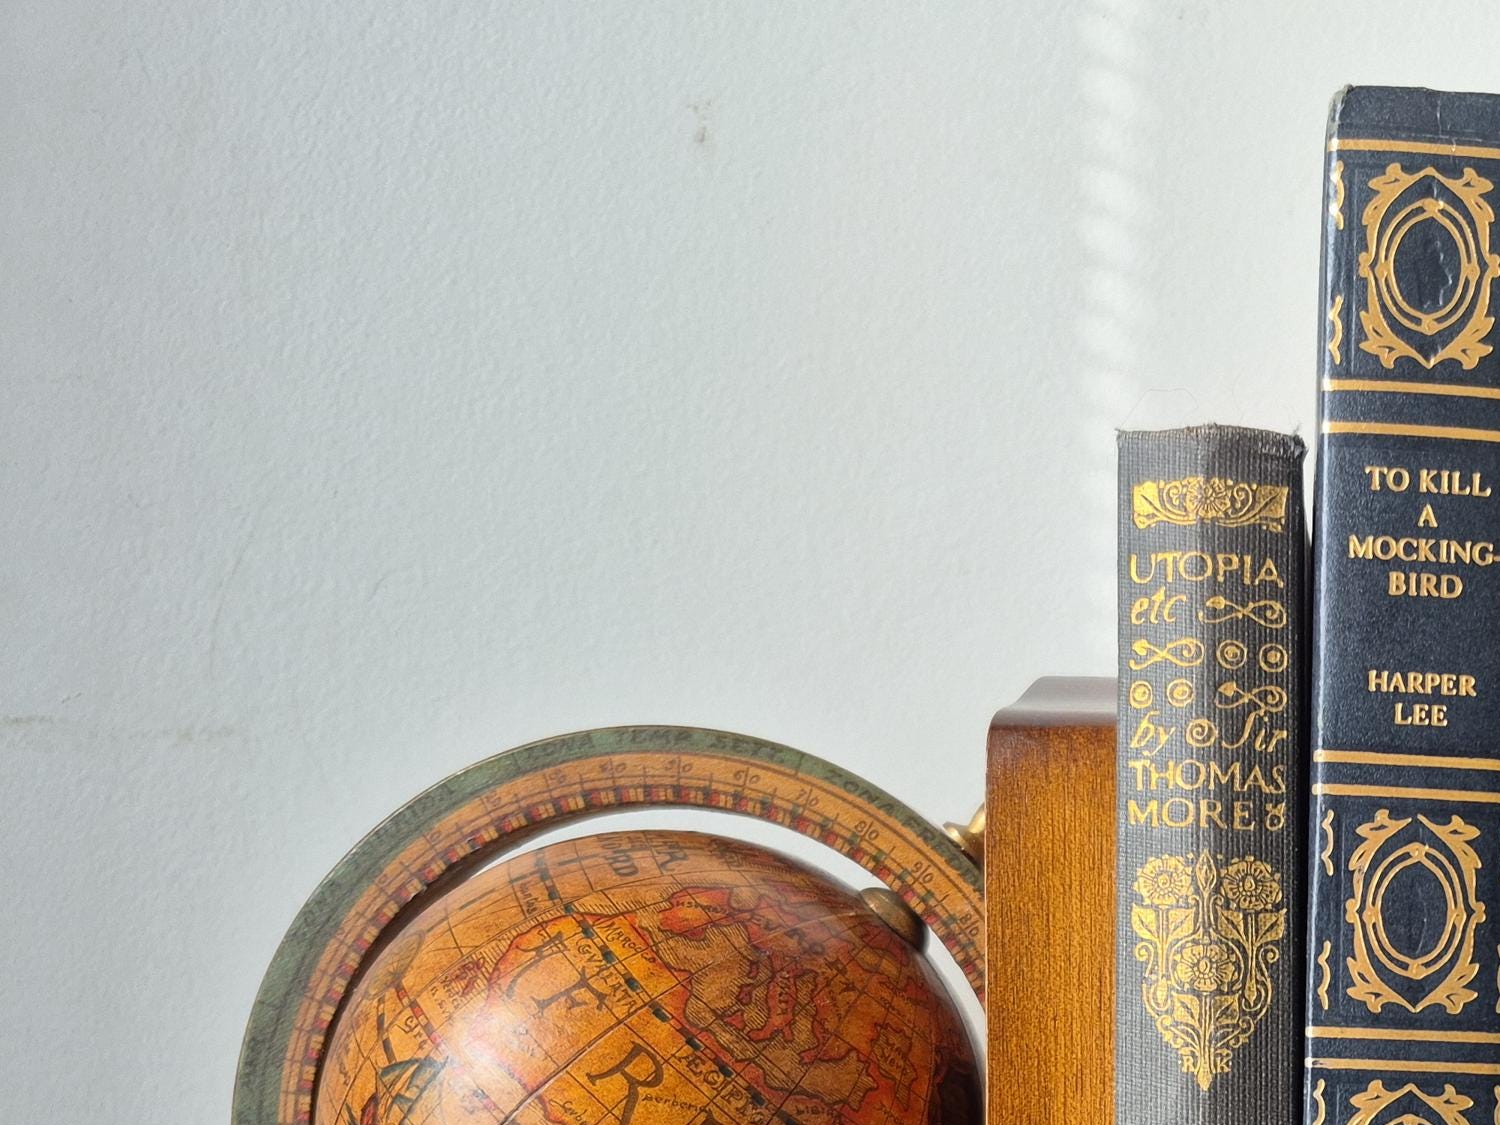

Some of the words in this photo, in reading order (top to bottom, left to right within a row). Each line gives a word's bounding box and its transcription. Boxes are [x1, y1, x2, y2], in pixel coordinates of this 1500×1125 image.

[1364, 466, 1410, 492] TO
[1418, 468, 1492, 497] KILL
[1417, 503, 1439, 528] A
[1128, 551, 1285, 588] UTOPIA
[1387, 571, 1464, 599] BIRD
[1130, 586, 1188, 624] etc
[1367, 669, 1477, 698] HARPER
[1394, 702, 1449, 727] LEE
[1129, 711, 1177, 756] by
[1128, 758, 1287, 794] THOMAS
[1127, 798, 1256, 832] MORE
[854, 820, 880, 842] 80
[913, 860, 935, 885] 90
